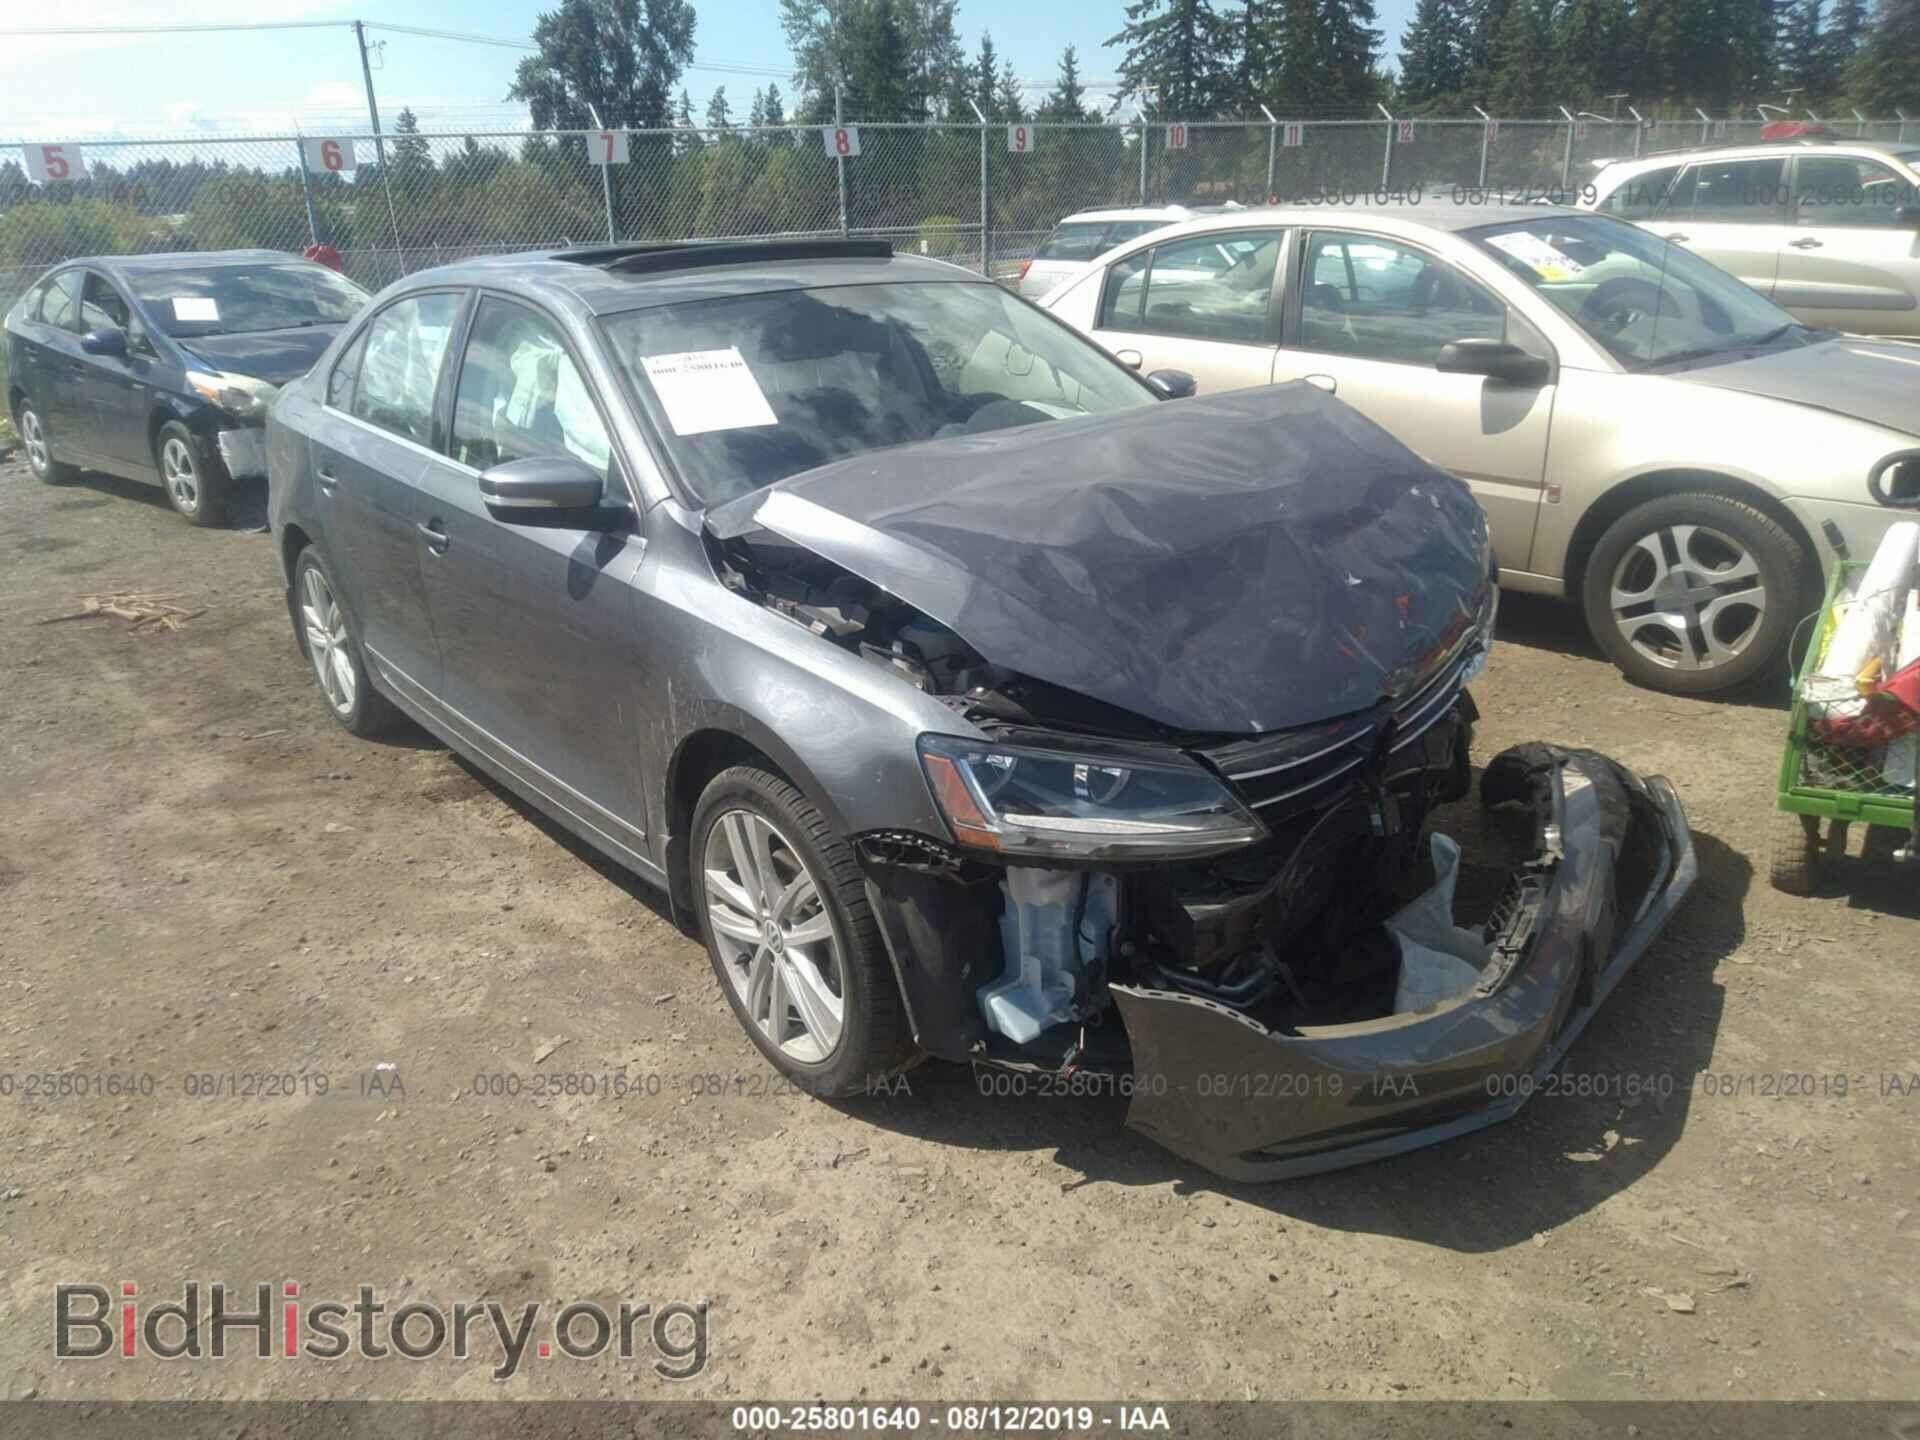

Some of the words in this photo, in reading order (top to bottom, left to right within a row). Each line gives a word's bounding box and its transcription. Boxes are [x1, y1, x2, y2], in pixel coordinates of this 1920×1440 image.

[599, 133, 614, 162] 7
[834, 128, 850, 156] 8
[1015, 127, 1026, 151] 9
[1169, 126, 1185, 147] 10
[1287, 126, 1299, 145] 11
[41, 144, 70, 179] 5
[320, 139, 344, 172] 6
